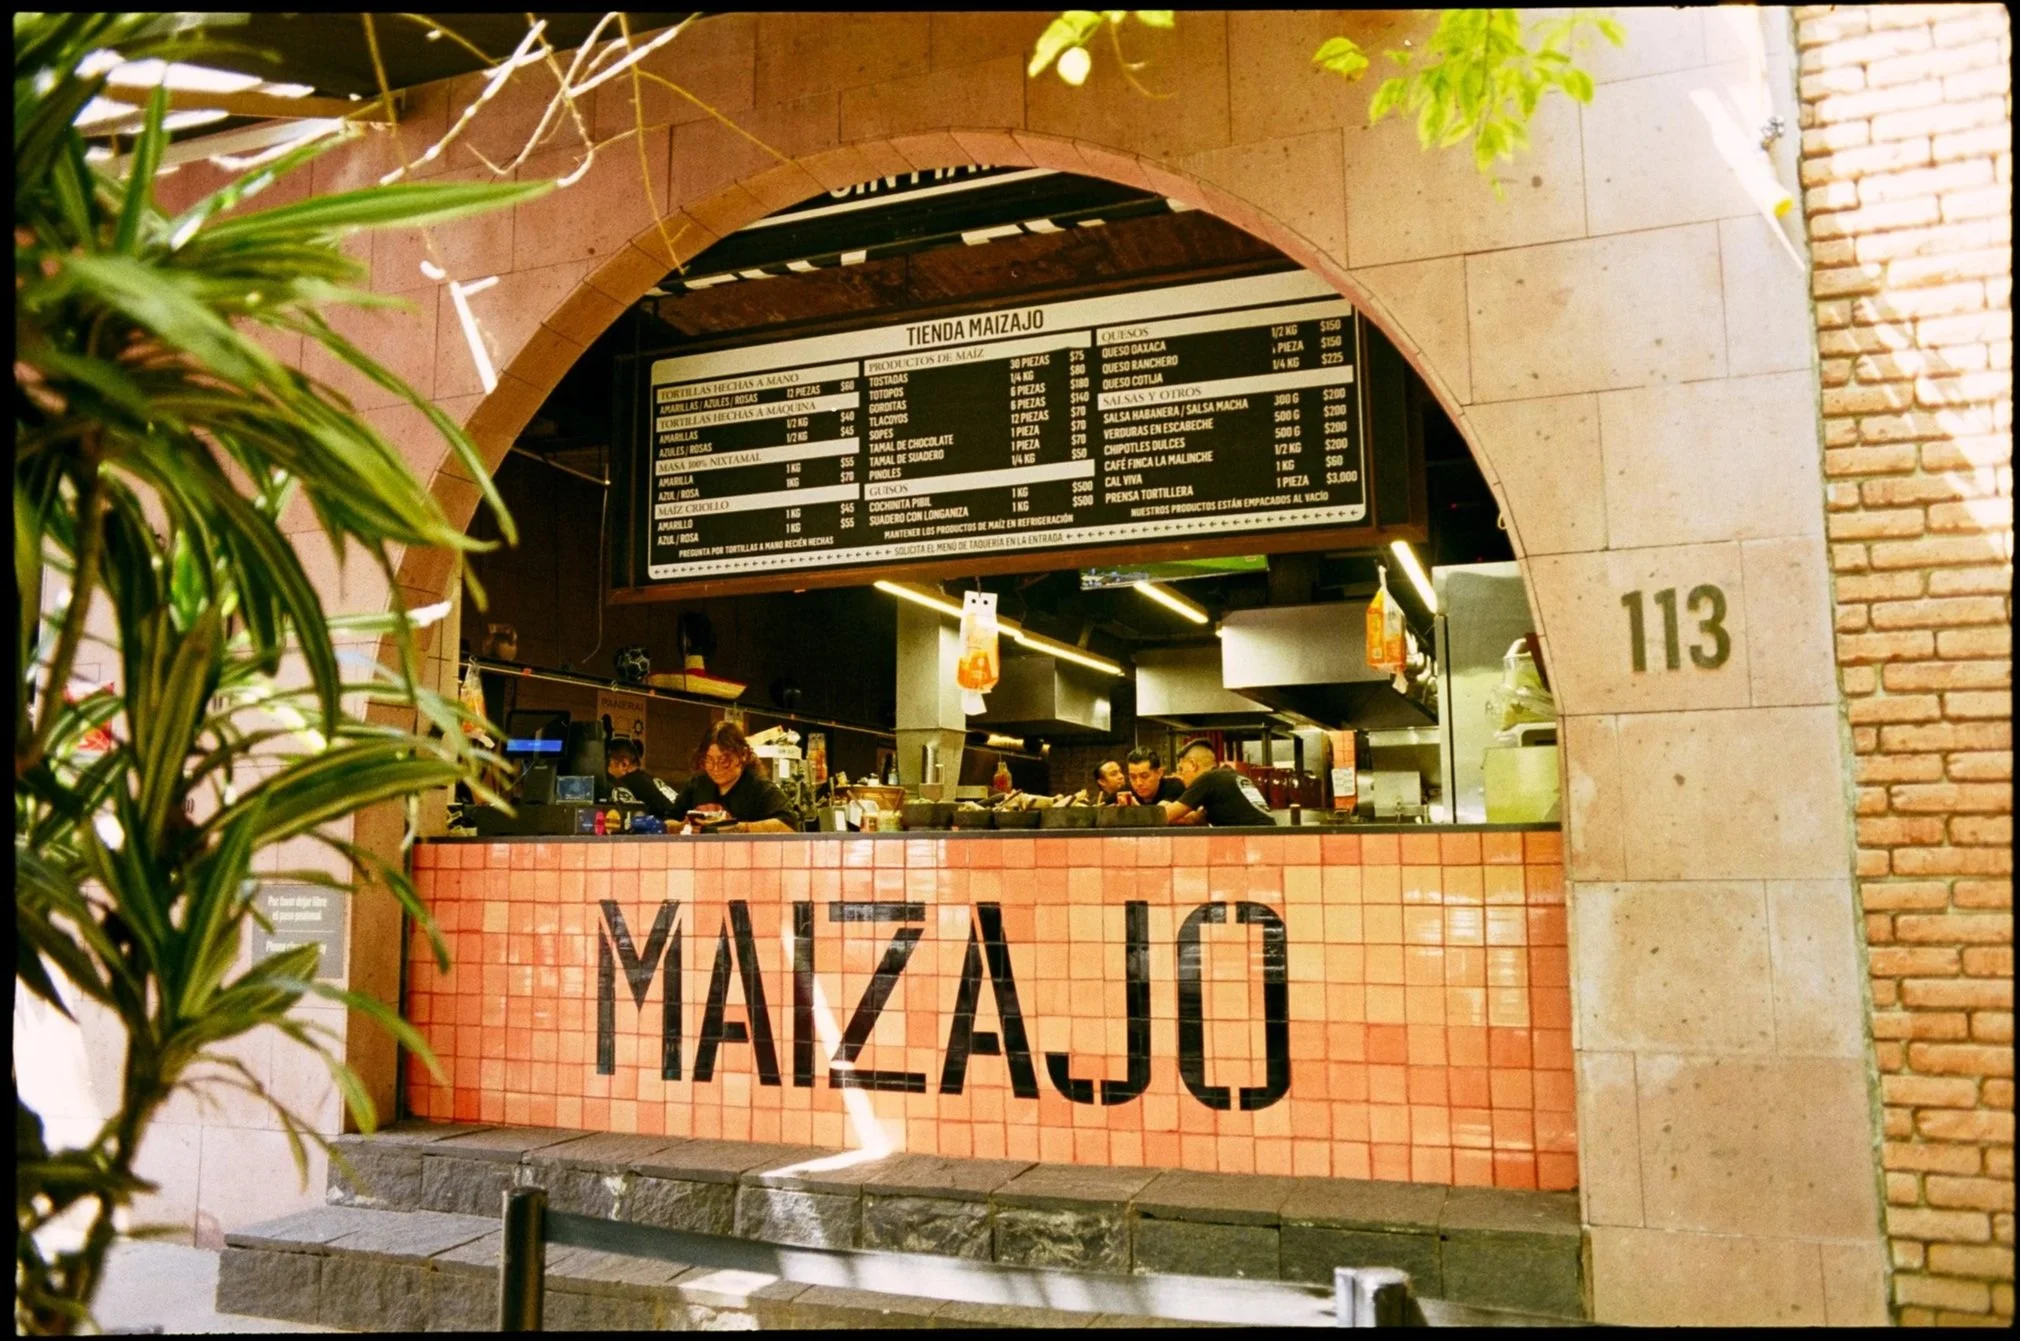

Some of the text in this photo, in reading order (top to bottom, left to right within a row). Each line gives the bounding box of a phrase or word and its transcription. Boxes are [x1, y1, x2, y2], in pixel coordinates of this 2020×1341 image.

[907, 309, 1044, 346] TIENDA MAIZAJO
[1101, 326, 1149, 342] QUESOS
[1101, 318, 1341, 358] QUESO OAXACA 1/2 KG $150
[868, 347, 984, 372] PRODUCTOS DE MAÍZ
[868, 350, 1084, 387] TOSTADAS 30 PIEZAS $75
[1102, 335, 1341, 374] QUESO RANCHERO PIEZA $150
[1102, 351, 1344, 390] QUESO COTIJA 1/4 KG $225
[660, 373, 798, 399] TORTILLAS HECHAS MANO
[869, 364, 1085, 400] TOTOPOS 1/4 KG $80
[869, 377, 1089, 413] GORDITAS PIEZAS $180
[1102, 386, 1201, 406] SALSAS OTROS
[659, 400, 698, 414] AMARILLAS
[703, 396, 729, 409] AZULES
[734, 392, 758, 405] ROSAS
[786, 388, 794, 399] 12
[795, 385, 820, 398] PIEZAS
[869, 392, 1089, 427] TLACOYOS PIEZAS $140
[1103, 411, 1130, 424] SALSA
[1131, 405, 1179, 421] HABANERA
[1186, 402, 1214, 415] SALSA
[1216, 398, 1248, 412] MACHA
[1323, 387, 1346, 400] $200
[659, 408, 754, 428] TORTILLAS HECHAS
[659, 411, 854, 444] AMARILLAS 1/2 KG $40
[869, 406, 1086, 440] SOPES 12 PIEZAS $70
[1103, 403, 1346, 440] VERDURAS ESCABECHE 500 $200
[658, 425, 854, 457] AZULES ROSAS 1/2 KG $45
[869, 419, 1086, 453] TAMAL CHOCOLATE PIEZA $70
[869, 434, 1086, 467] TAMAL SUADERO PIEZA $70
[1103, 420, 1347, 456] CHIPOTLES DULCES 500 $200
[658, 460, 685, 472] MASA
[709, 452, 762, 467] NIXTAMAL
[869, 447, 1087, 480] PINOLES 1/4 KG $50
[1104, 437, 1348, 472] CAFÉ FINCA MALINCHE 1/2 KG $200
[658, 457, 854, 487] AMARILLA $55
[658, 471, 854, 501] AZUL ROSA $70
[1104, 475, 1122, 488] CAL
[1123, 473, 1143, 486] VIVA
[869, 483, 908, 496] GUISOS
[869, 480, 1093, 512] COCHINITA PIBIL $500
[1104, 474, 1309, 504] PRENSA TORTILLERA PIEZA
[657, 503, 854, 531] AMARILLO $45
[658, 500, 728, 516] MAÍZ CRIOLLO
[869, 494, 1094, 526] SUADERO CON LONGANIZA $500
[1130, 505, 1169, 517] NUESTROS
[1170, 501, 1216, 514] PRODUCTOS
[1243, 494, 1291, 507] EMPACADOS
[657, 517, 854, 545] AZUL ROSA $55
[884, 527, 920, 539] MANTENER
[921, 526, 935, 535] LOS
[936, 522, 976, 534] PRODUCTOS
[988, 518, 1006, 529] MAÍZ
[894, 545, 925, 556] SOLICITA
[1028, 533, 1062, 544] ENTRADA
[678, 547, 710, 558] PREGUNTA
[711, 545, 724, 555] POR
[725, 542, 758, 554] TORTILLAS
[764, 540, 783, 550] MANO
[807, 535, 833, 546] HECHAS
[1620, 584, 1731, 672] 113
[597, 899, 1291, 1111] MAIZAJO
